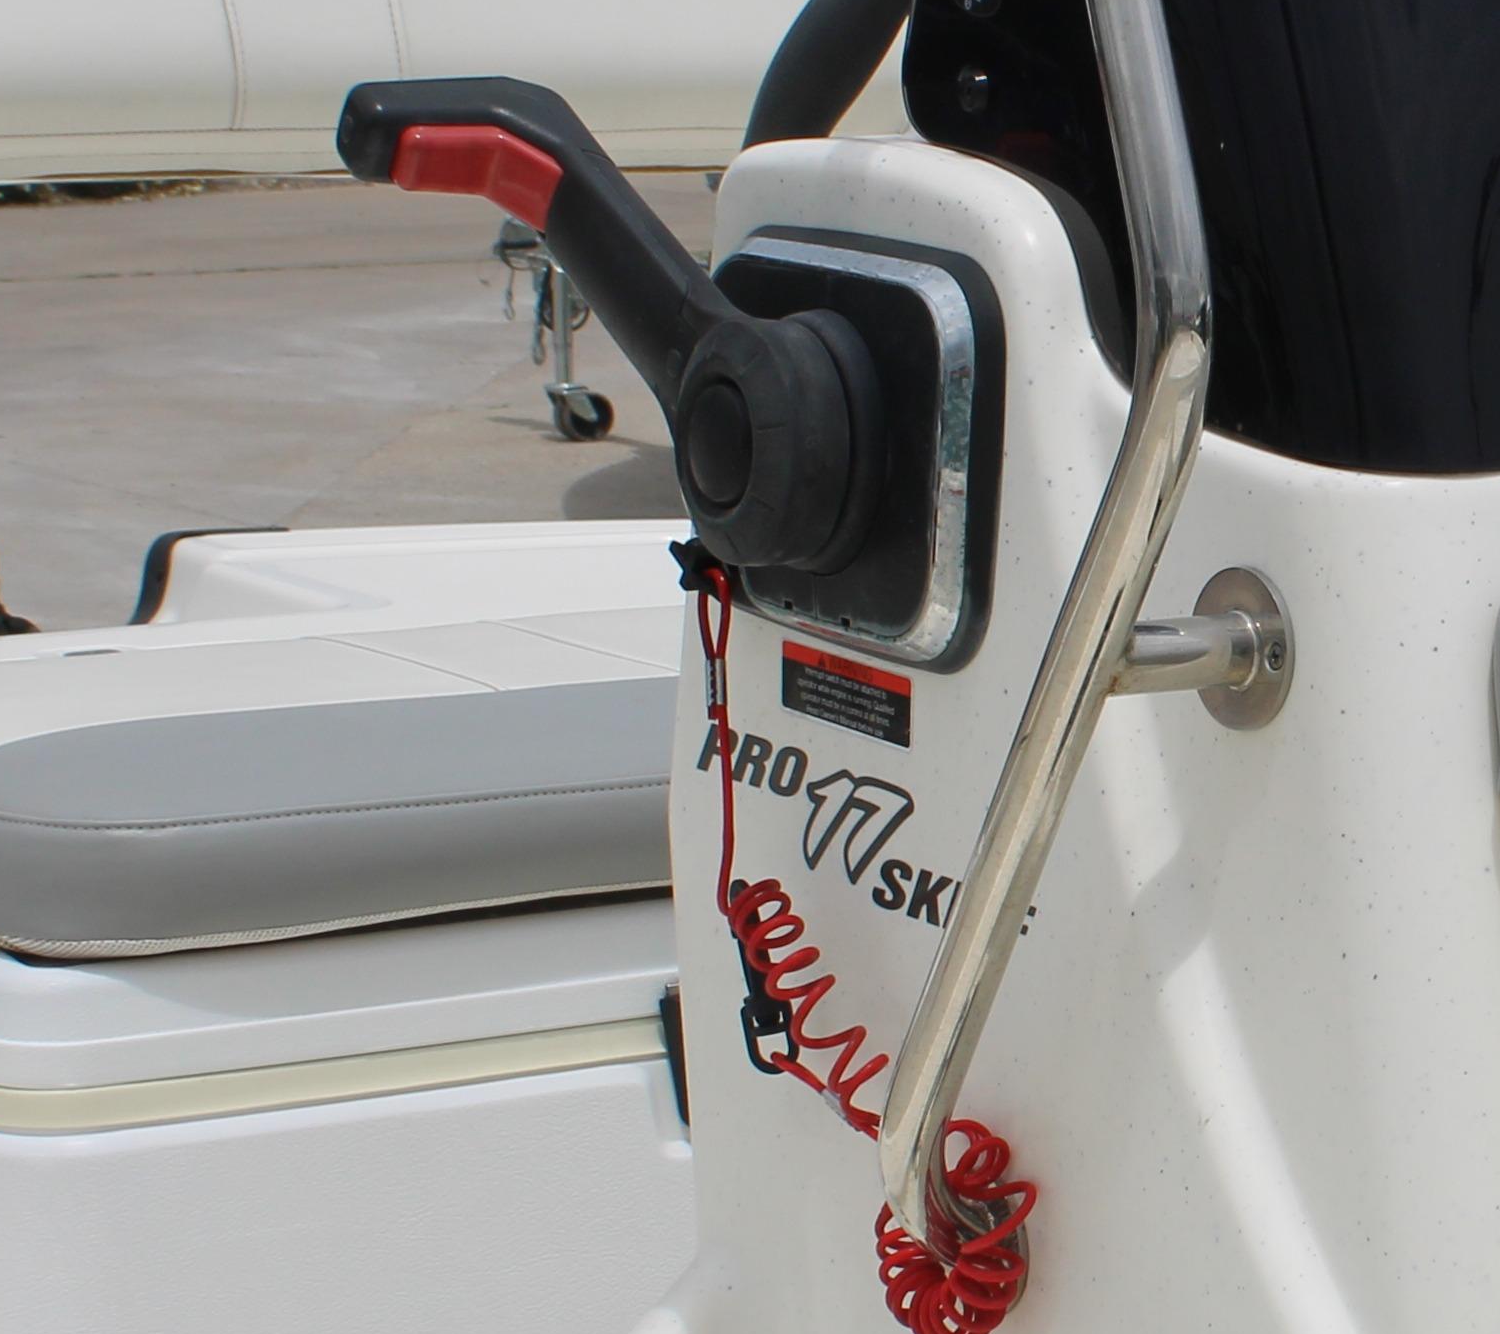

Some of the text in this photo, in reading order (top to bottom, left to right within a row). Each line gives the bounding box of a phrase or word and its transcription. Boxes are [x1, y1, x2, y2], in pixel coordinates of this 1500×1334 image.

[696, 723, 1037, 934] PRO 17 SKI
